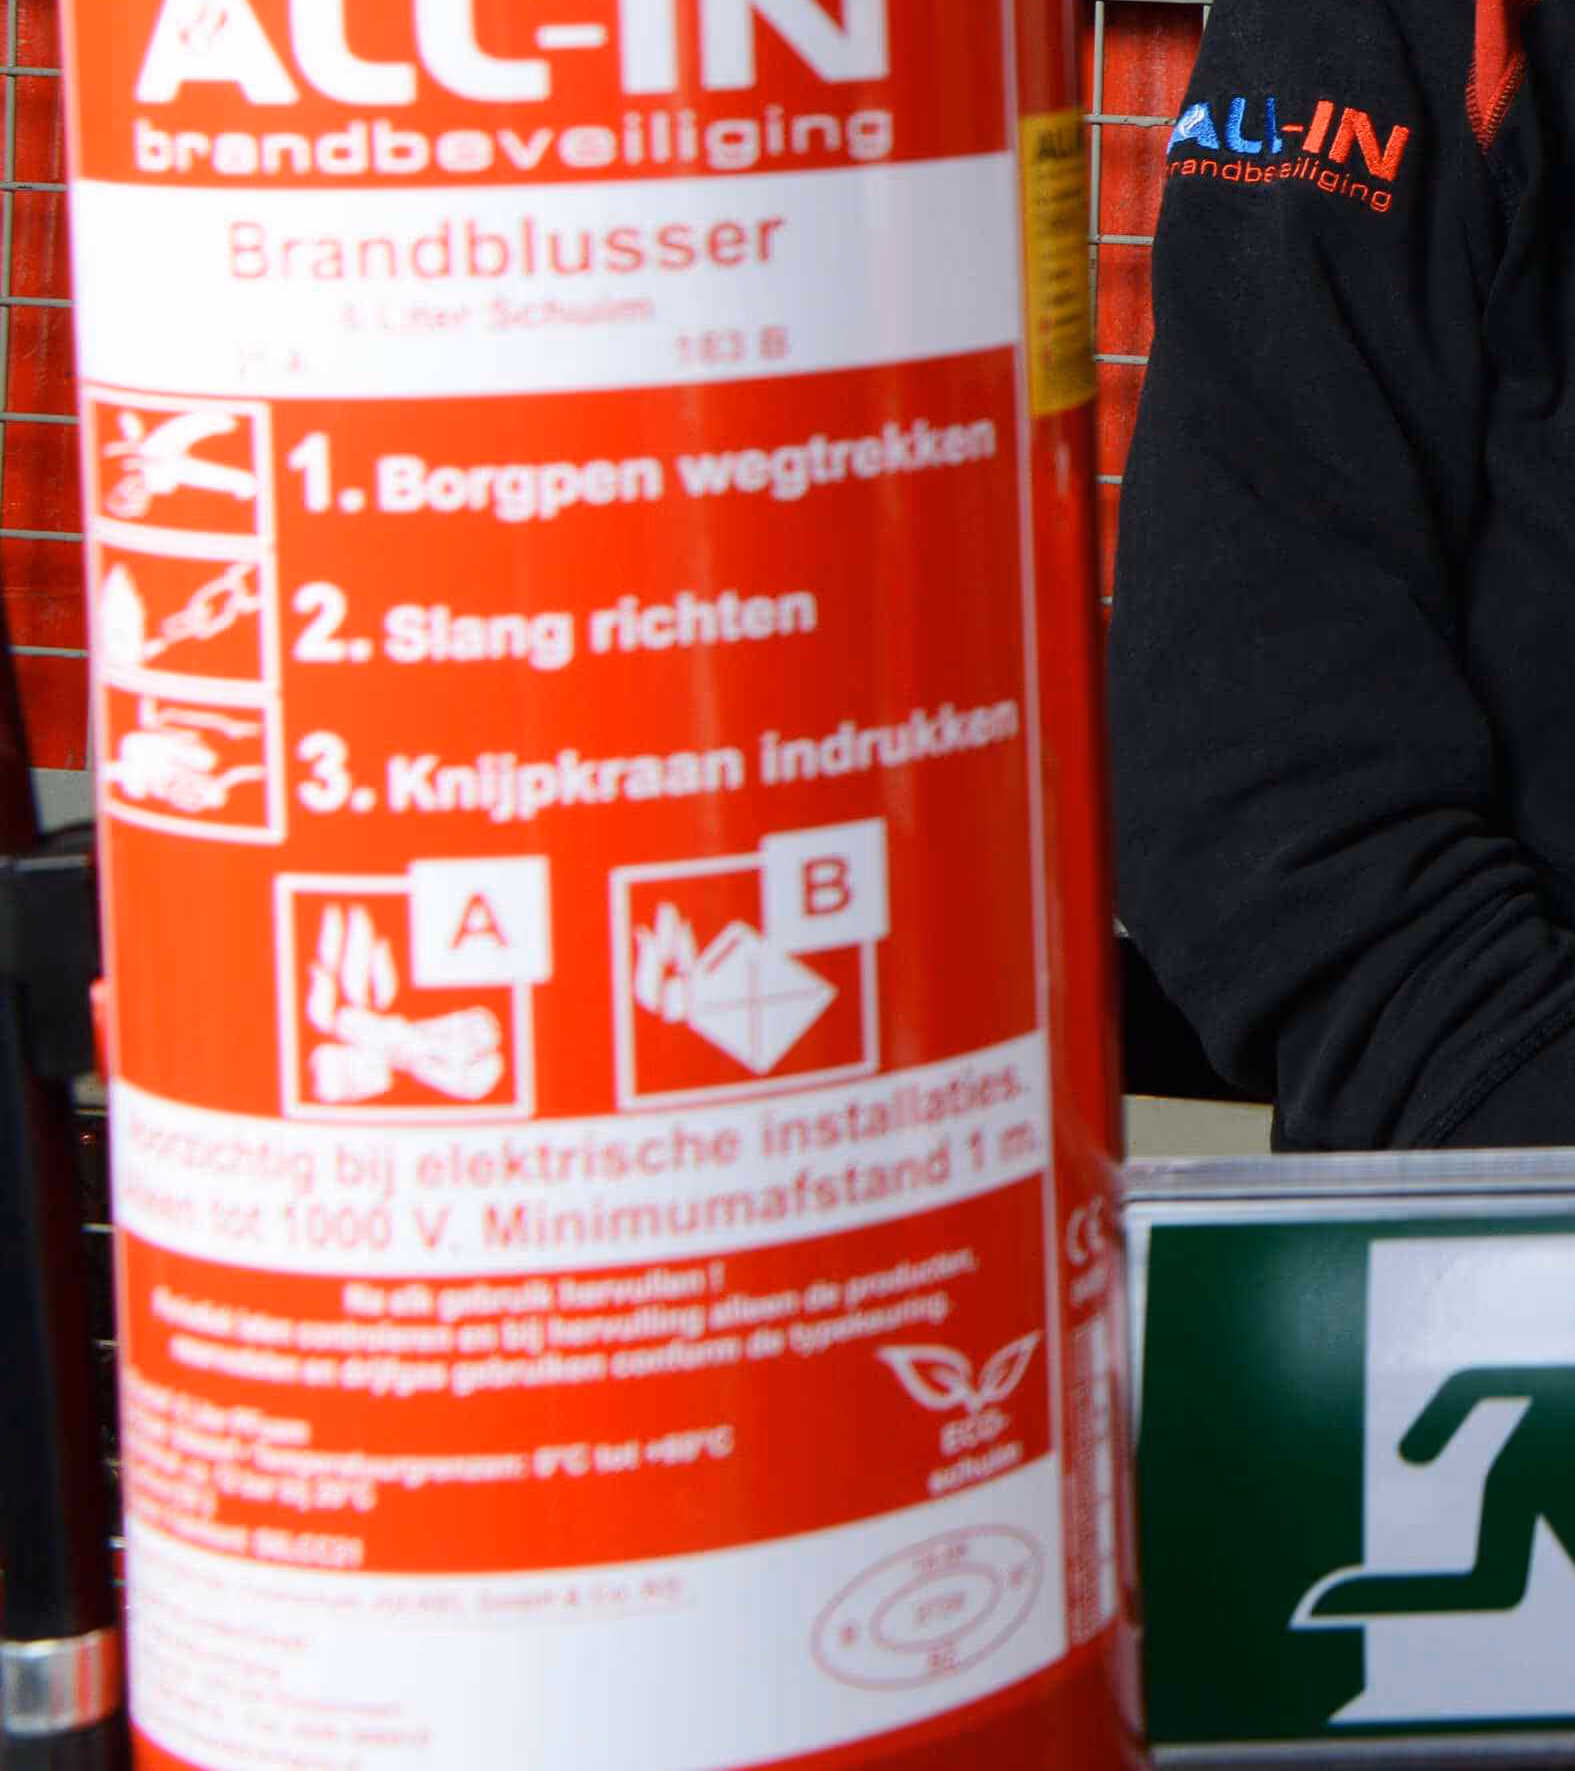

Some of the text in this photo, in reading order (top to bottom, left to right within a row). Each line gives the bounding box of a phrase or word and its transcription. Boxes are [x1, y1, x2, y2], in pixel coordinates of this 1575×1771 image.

[133, 105, 893, 177] brandbeveiliging
[225, 215, 784, 280] Brandblusser
[760, 326, 788, 360] B
[287, 416, 996, 521] 1. Borgpen wegtrekken
[293, 585, 816, 668] 2. Slang richten
[298, 698, 1018, 821] 3. Knijpkraan indrukken
[449, 893, 509, 950] A
[804, 859, 851, 916] B
[283, 1203, 393, 1250] 1000
[483, 1143, 949, 1250] Minimumafstand
[334, 1141, 395, 1198] bij
[416, 1124, 741, 1188] elektrische
